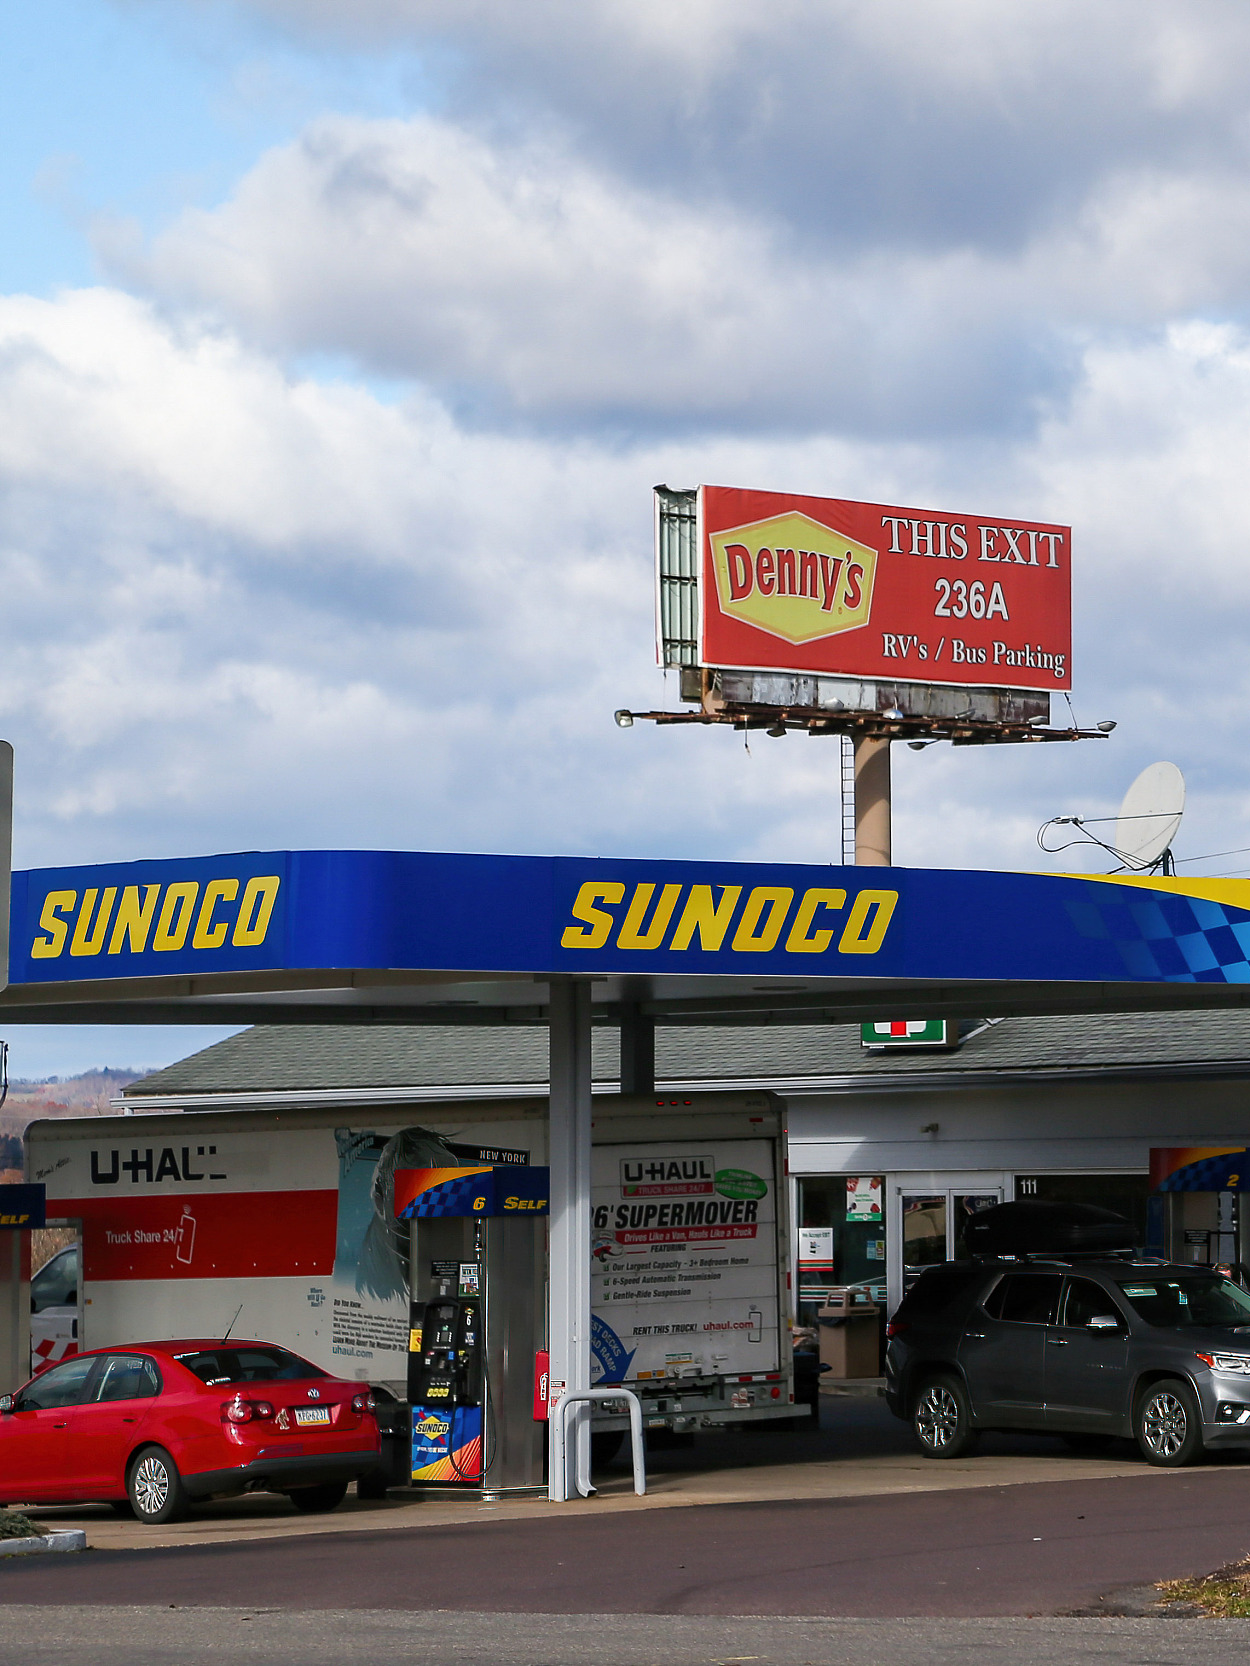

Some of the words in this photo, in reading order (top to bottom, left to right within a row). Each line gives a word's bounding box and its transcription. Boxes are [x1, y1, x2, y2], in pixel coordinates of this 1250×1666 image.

[881, 516, 968, 560] THIS
[977, 525, 1064, 569] EXIT
[723, 543, 867, 613] Denny's
[934, 577, 1010, 621] 236A
[882, 633, 928, 660] RV's
[951, 638, 987, 664] Bus
[993, 640, 1066, 678] Parking
[31, 875, 280, 959] SUNOCO
[560, 881, 899, 954] SUNOCO
[479, 1150, 499, 1161] NEW
[502, 1151, 526, 1164] YORK
[624, 1160, 711, 1182] U-HAUL
[1020, 1178, 1037, 1194] 111
[1226, 1174, 1240, 1187] 2
[638, 1186, 662, 1196] TRUCK
[664, 1185, 687, 1194] SHARE
[689, 1184, 705, 1193] 24/7
[472, 1197, 486, 1210] 6
[0, 1213, 30, 1225] ELF
[615, 1200, 759, 1229] SUPERMOVER
[105, 1230, 131, 1244] Truck
[134, 1229, 160, 1243] Share
[163, 1228, 184, 1245] 24/7
[624, 1232, 647, 1242] Drives
[649, 1231, 664, 1241] Like
[688, 1229, 708, 1239] Hauls
[710, 1228, 725, 1238] Like
[733, 1227, 752, 1237] Truck
[651, 1244, 686, 1253] FEATURING
[612, 1263, 625, 1271] Our
[626, 1262, 651, 1273] Largest
[653, 1260, 681, 1270] Capacity
[700, 1258, 728, 1267] Bedroom
[730, 1257, 749, 1265] Home
[612, 1276, 640, 1286] 6-Speed
[642, 1274, 676, 1284] Automatic
[678, 1272, 721, 1282] Transmission
[613, 1290, 652, 1300] Gentle-Ride
[653, 1288, 691, 1298] Suspension
[466, 1315, 472, 1326] 6
[703, 1320, 754, 1331] uhaul.com
[633, 1326, 652, 1336] RENT
[653, 1325, 670, 1335] THIS
[671, 1323, 697, 1334] TRUCK!
[332, 1345, 374, 1358] uhaul.com
[417, 1423, 448, 1433] SUNOCO
